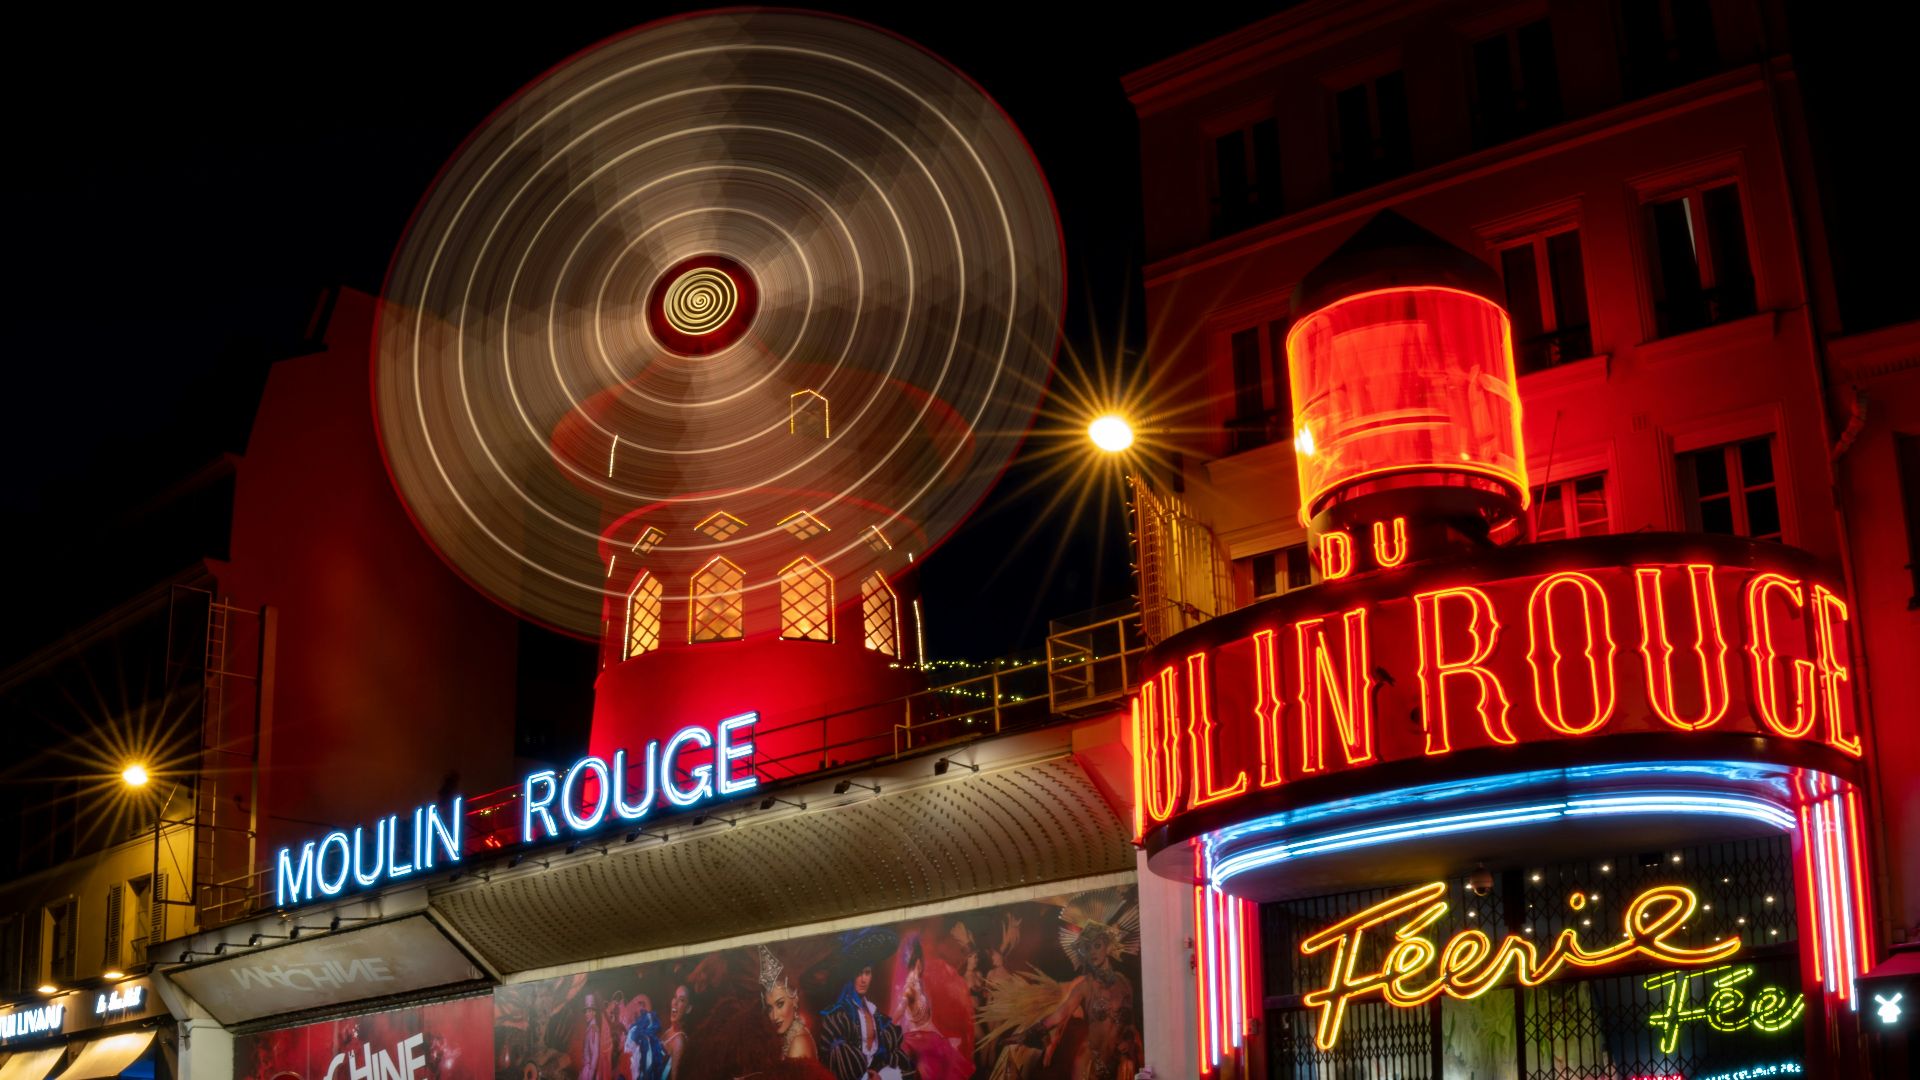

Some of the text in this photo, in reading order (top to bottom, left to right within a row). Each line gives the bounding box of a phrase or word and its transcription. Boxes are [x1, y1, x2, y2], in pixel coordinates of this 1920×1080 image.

[1320, 517, 1407, 580] DU
[1414, 563, 1862, 757] ROUGE
[276, 710, 761, 907] MOULIN ROUGE
[1302, 881, 1742, 1051] Féerie
